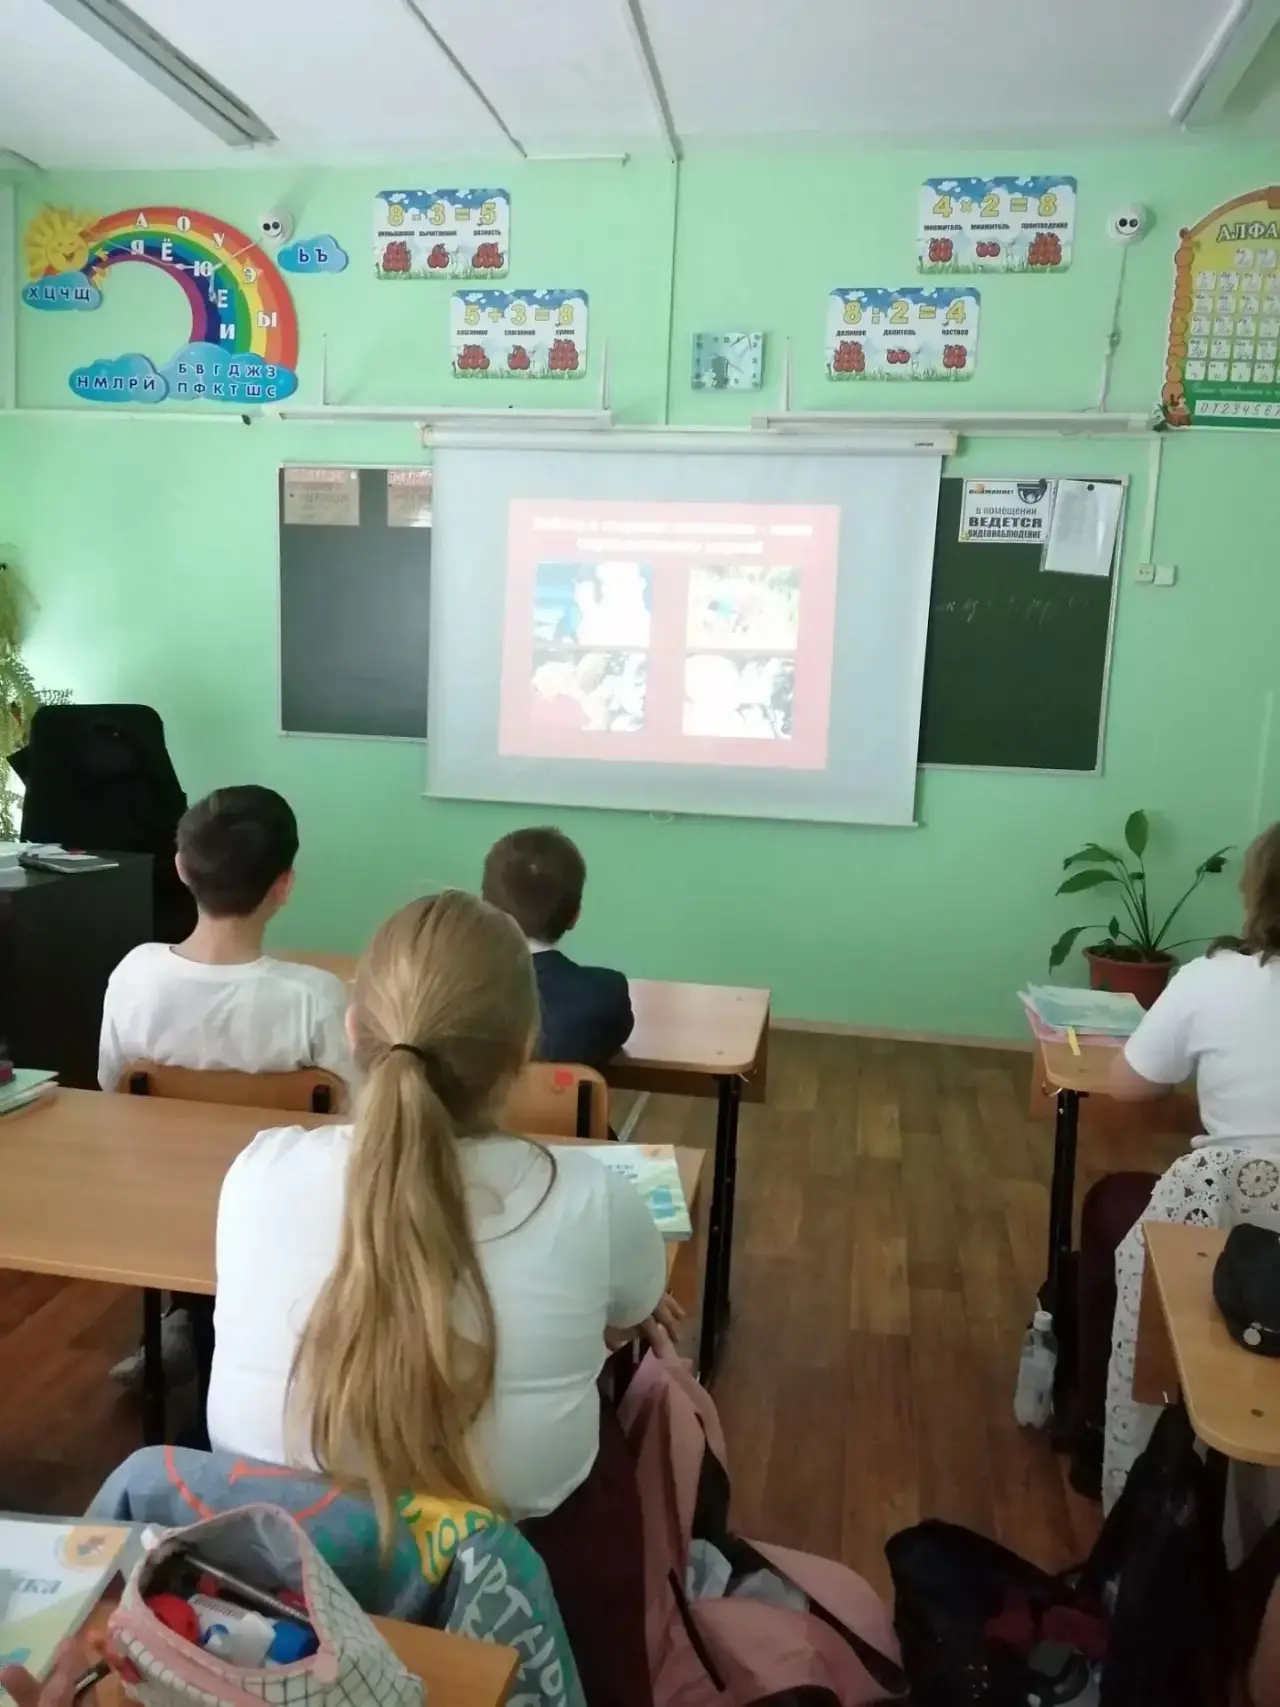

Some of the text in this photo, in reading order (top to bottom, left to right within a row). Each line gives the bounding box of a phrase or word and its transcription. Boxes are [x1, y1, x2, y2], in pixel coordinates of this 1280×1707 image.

[388, 204, 404, 226] 8
[429, 203, 445, 226] 3
[480, 203, 496, 225] 5
[933, 195, 953, 218] 4
[980, 193, 1000, 217] 2
[1038, 193, 1057, 216] 8
[464, 304, 480, 325] 5
[511, 304, 527, 325] 3
[844, 300, 862, 324] 8
[890, 300, 909, 324] 2
[946, 300, 966, 324] 4
[976, 507, 1037, 516] В ПОМЕЩЕНИИ
[969, 516, 1042, 529] ВЕДЕТСЯ
[968, 529, 1042, 540] ВИДЕОНАБЛЮДЕНИЕ
